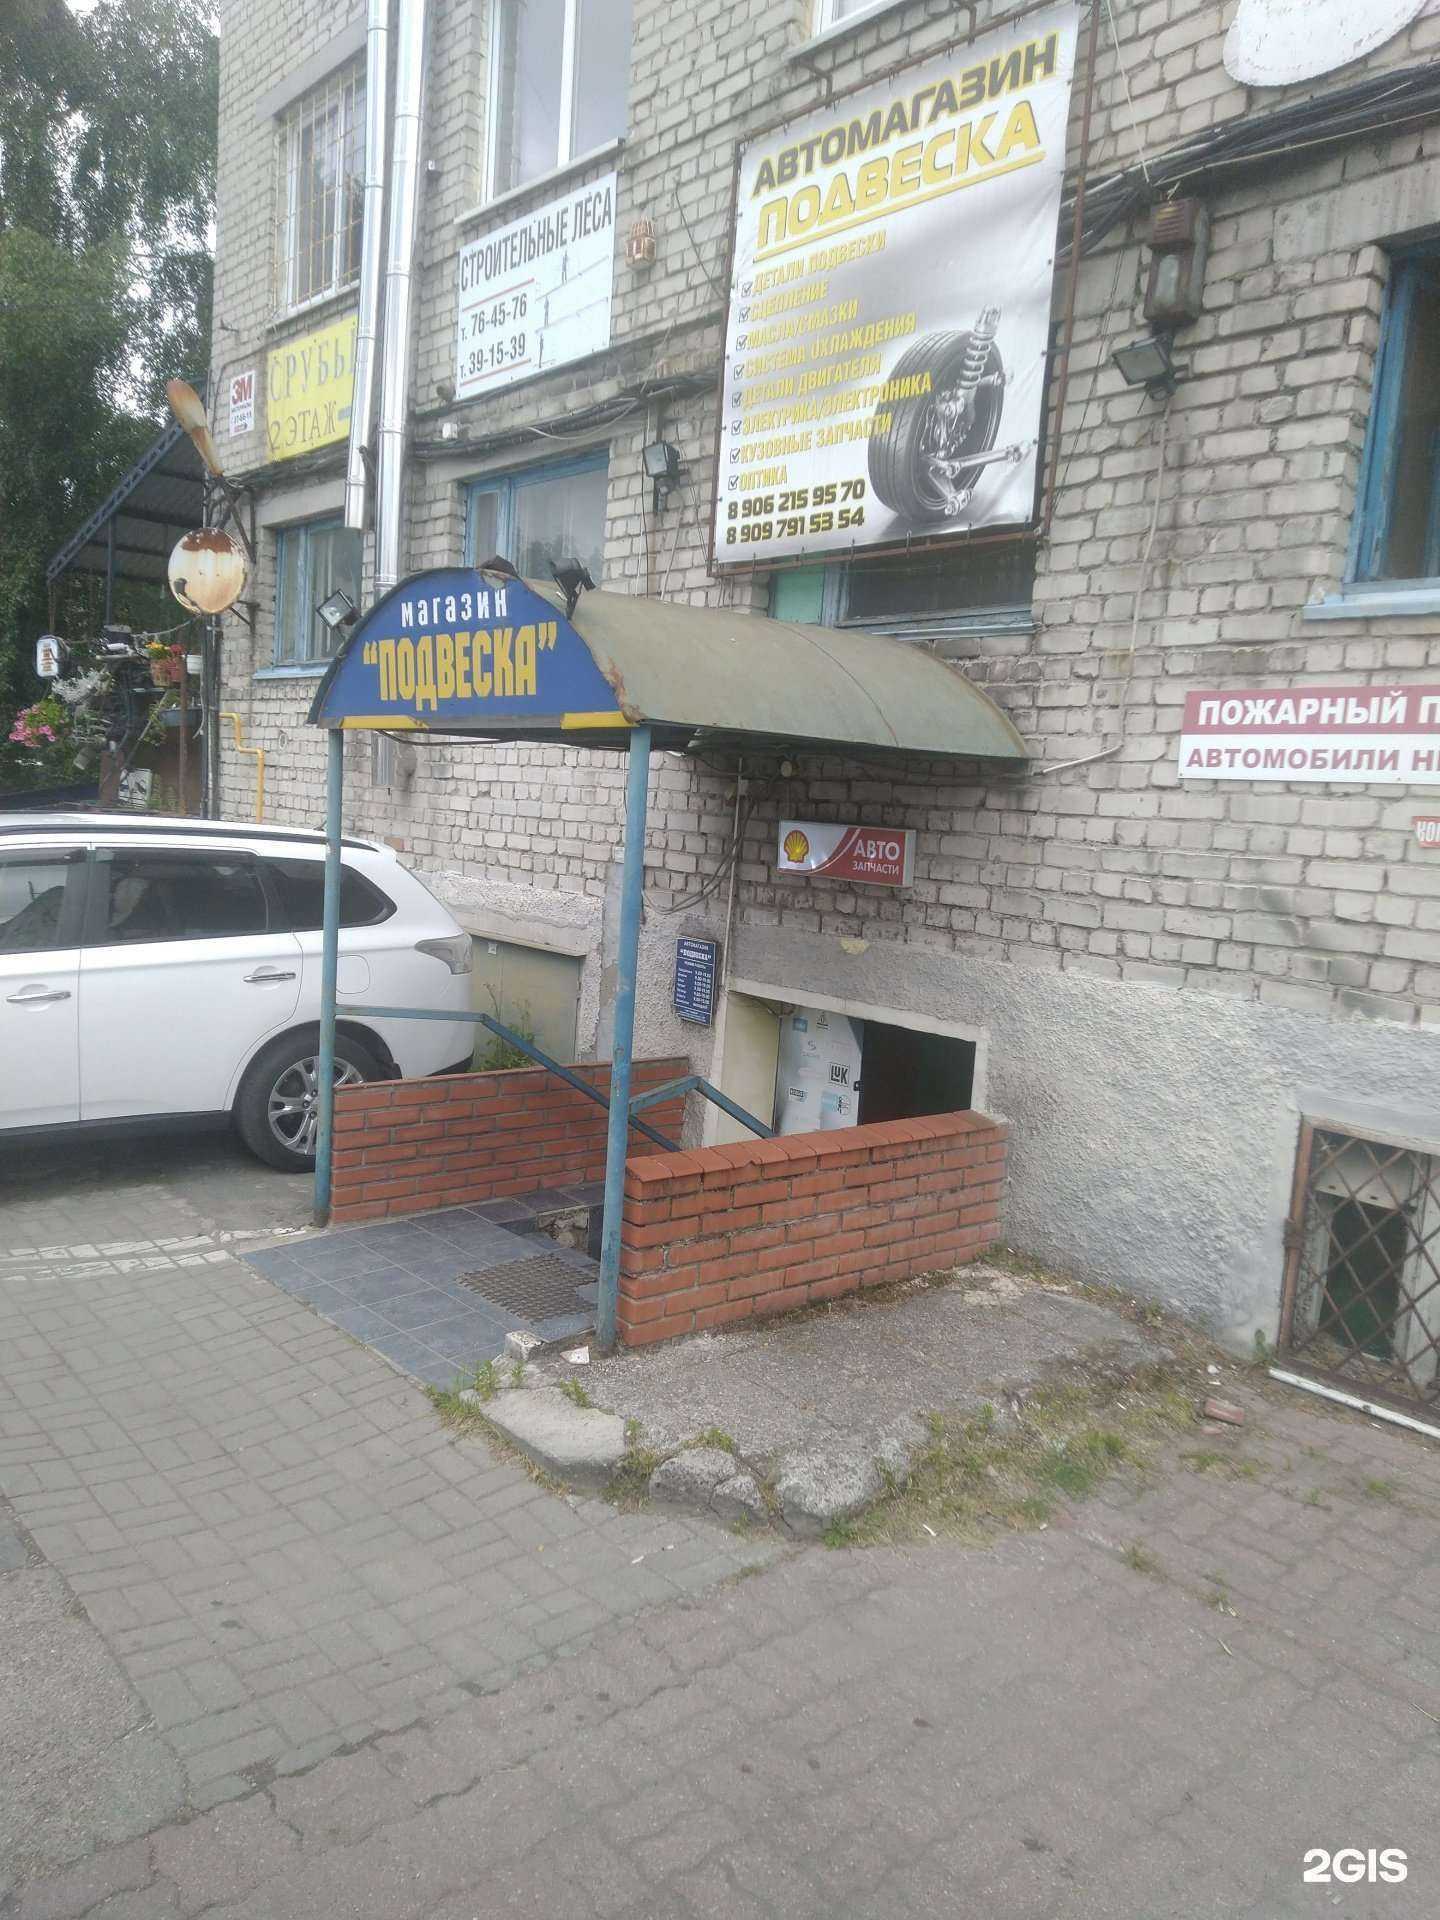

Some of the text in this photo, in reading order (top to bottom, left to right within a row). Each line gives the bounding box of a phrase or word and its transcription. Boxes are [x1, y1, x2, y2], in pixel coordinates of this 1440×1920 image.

[752, 33, 1059, 197] АВТОМАГАЗИН
[757, 100, 1041, 249] ПОДВЕСКА
[461, 187, 612, 292] СТРОИТЕЛЬНЫЕ ЛЕСА
[752, 231, 887, 296] ДЕТАЛИ ПОДВЕСКИ
[471, 293, 527, 336] 76-45-76
[750, 279, 829, 322] СЦЕПЛЕНИЕ
[468, 332, 526, 375] 39-15-39
[745, 311, 917, 378] СИСТЕМА ОХЛАЖДЕНИЯ
[742, 352, 882, 411] ДЕТАЛИ ДВИГАТЕЛЯ
[269, 400, 337, 450] 2 ЭТАЖ
[742, 371, 933, 436] ЭЛЕКТРИКА/ЭЛЕКТРОНИКА
[740, 412, 893, 465] КУЗОВНЫЕ ЗАПЧАСТИ
[727, 478, 866, 520] 8 906 215 95 70
[739, 464, 788, 492] ОПТИКА
[726, 506, 865, 545] 8 909 791 53 54
[401, 588, 507, 628] магазин
[363, 621, 558, 712] "ПОДВЕСКА"
[1198, 690, 1408, 726] ПОЖАРНЫЙ
[1186, 748, 1399, 771] АВТОМОБИЛИ
[852, 860, 900, 875] ЗАПЧАСТИ
[853, 839, 900, 861] АВТО
